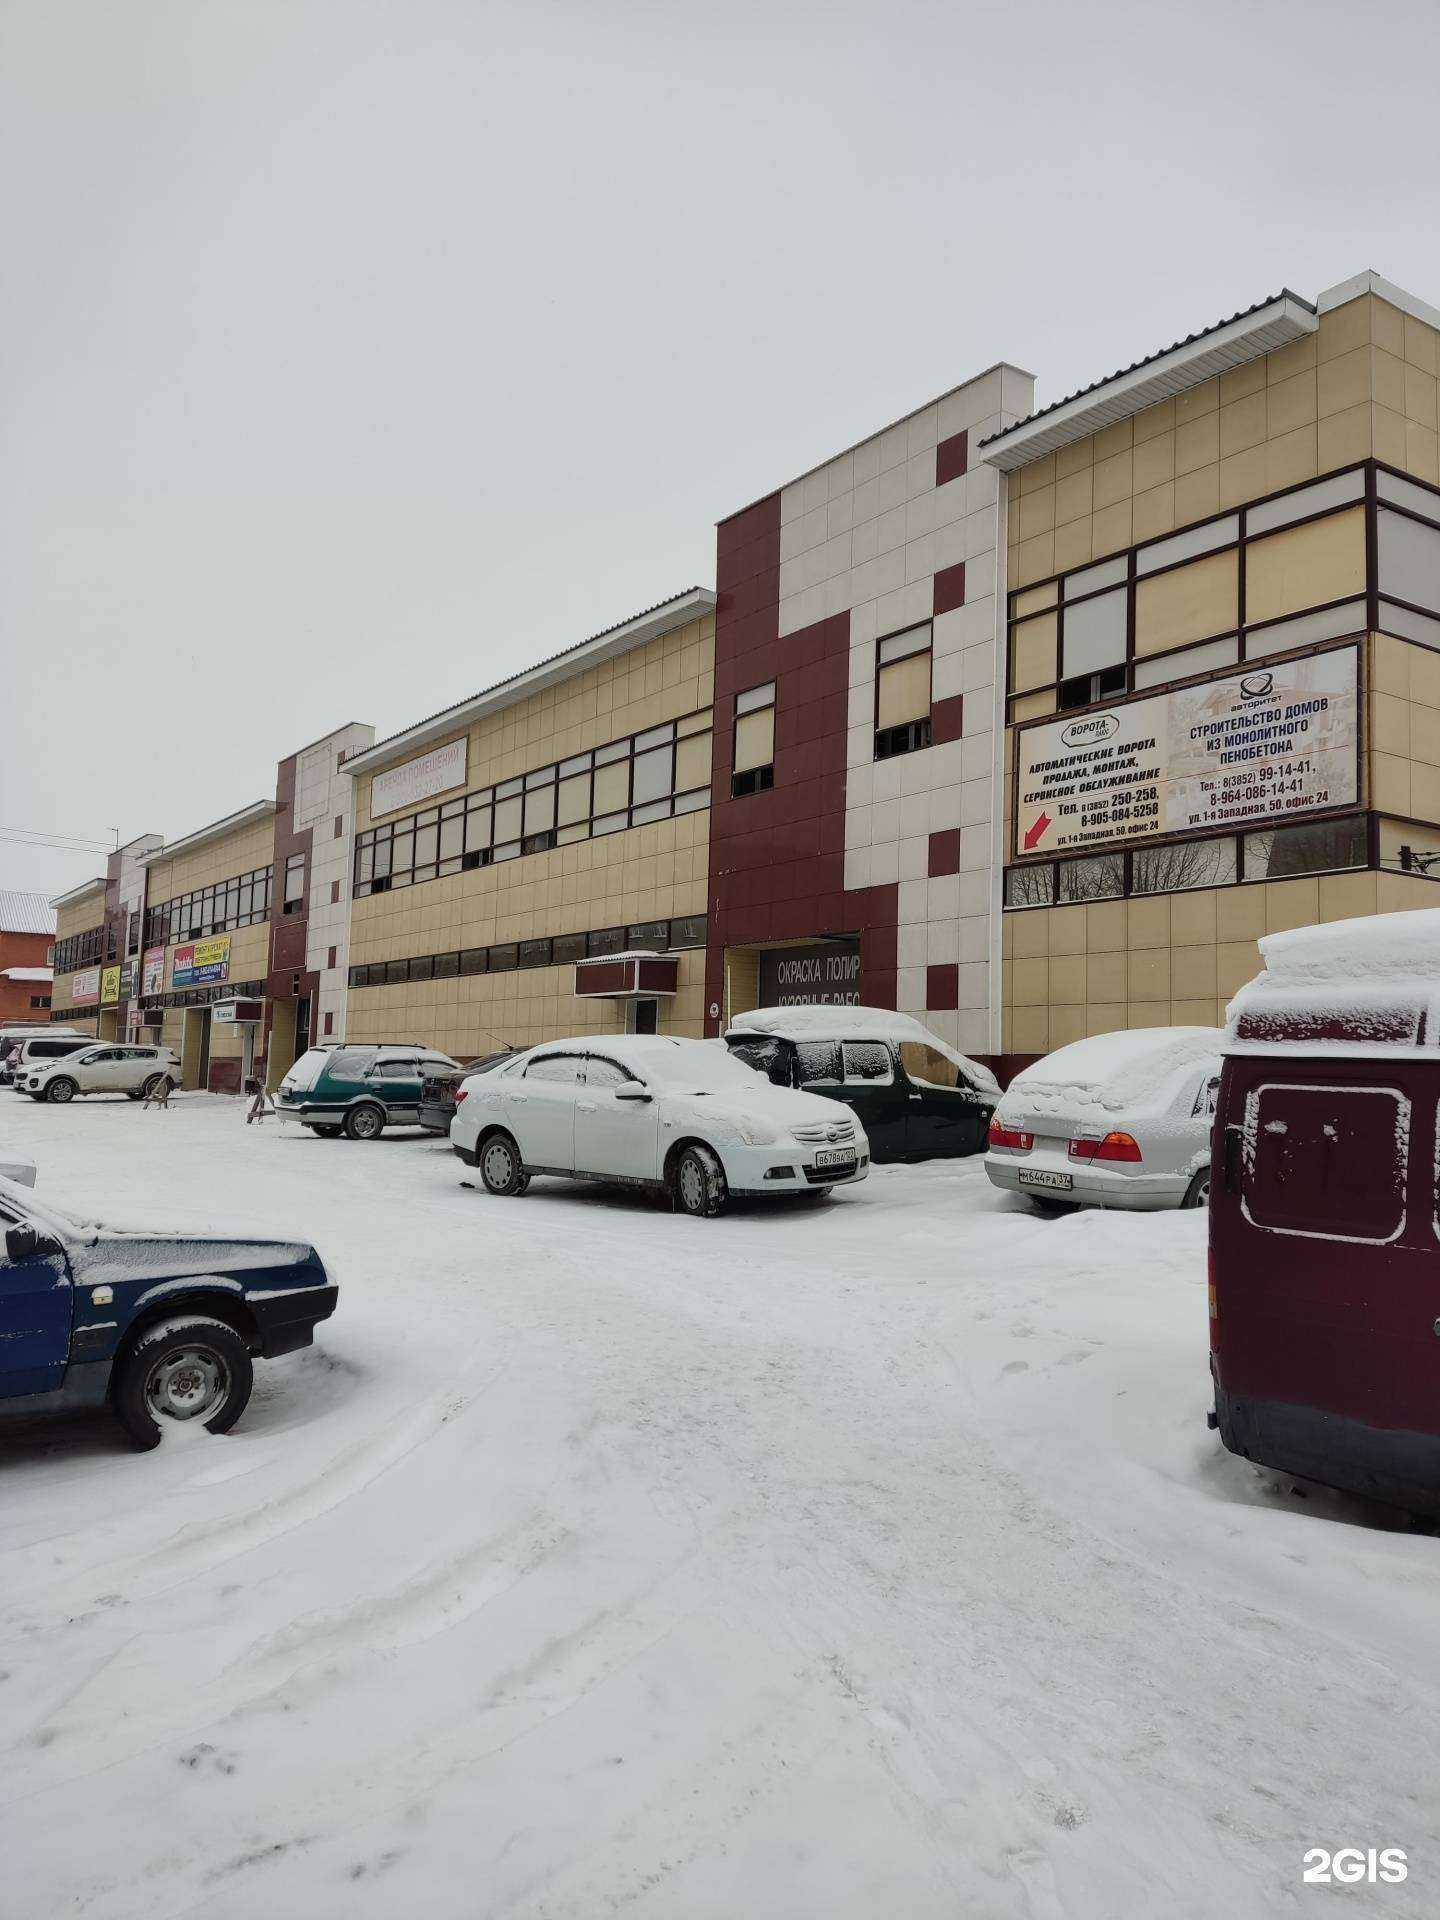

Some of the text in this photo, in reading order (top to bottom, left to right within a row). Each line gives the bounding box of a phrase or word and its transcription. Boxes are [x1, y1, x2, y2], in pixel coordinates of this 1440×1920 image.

[1230, 695, 1282, 712] авторитет
[1190, 698, 1329, 739] СТРОИТЕЛЬСТВО ДОМОВ
[1206, 719, 1309, 751] ИЗ МОНОЛИТНОГО
[1029, 738, 1156, 774] АВТОМАТИЧЕСКИЕ ВОРОТА
[1220, 739, 1293, 764] ПЕНОБЕТОНА
[1042, 757, 1139, 785] ПРОДАЖА, МОНТАЖ,
[1223, 772, 1256, 788] 8(3852)
[1259, 760, 1316, 781] 99-14-41,
[1024, 768, 1160, 803] СЕРВИСНОЕ ОБСЛУЖИВАНИЕ
[1210, 778, 1303, 806] 8-964-086-14-41
[1058, 803, 1079, 815] Тел.
[1081, 803, 1159, 827] 8-905-084-5258
[1188, 815, 1202, 824] ул.
[1203, 811, 1216, 821] 1-я
[1286, 795, 1314, 810] офис
[1316, 791, 1329, 803] 24
[1128, 824, 1149, 834] офис
[1149, 820, 1159, 830] 24
[778, 955, 860, 984] ОКРАСКА ПОЛИР
